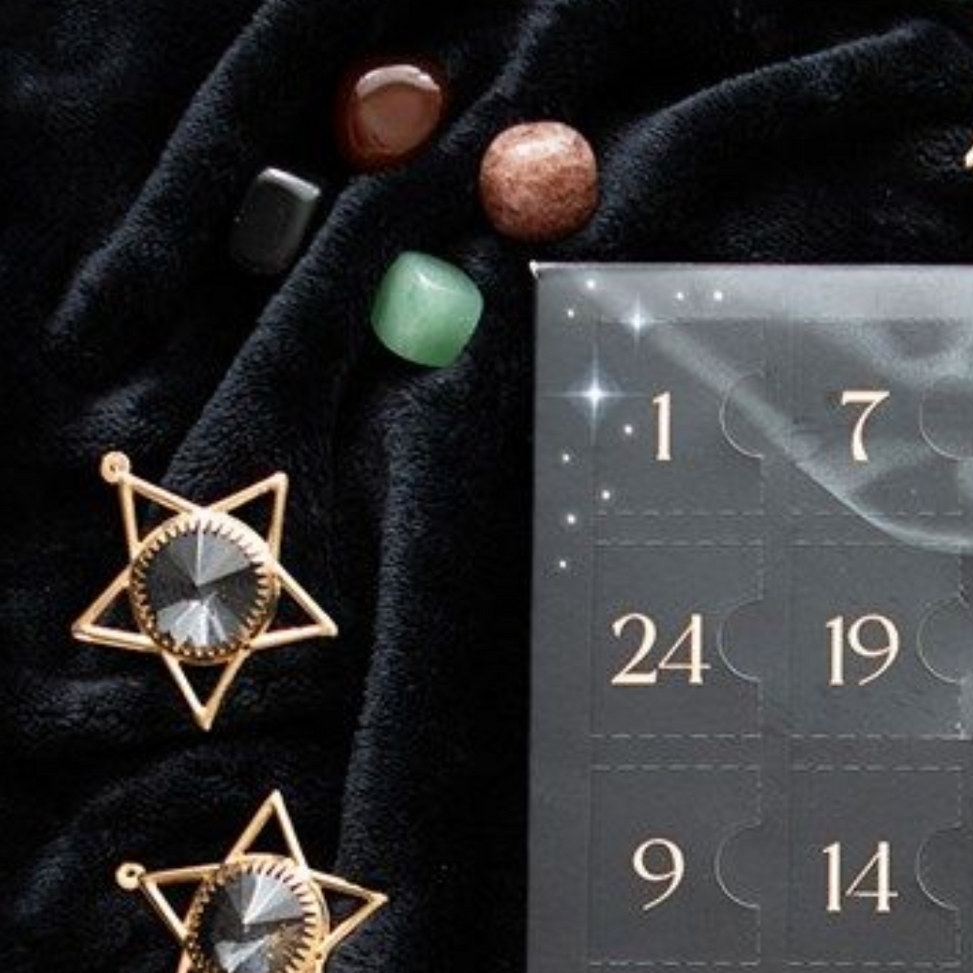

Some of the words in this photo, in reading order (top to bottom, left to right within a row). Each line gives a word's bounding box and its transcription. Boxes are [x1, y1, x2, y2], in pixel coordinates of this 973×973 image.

[651, 391, 671, 461] 1
[841, 390, 890, 462] 7
[611, 612, 711, 685] 24
[825, 613, 900, 686] 19
[632, 837, 685, 911] 9
[822, 840, 899, 913] 14
